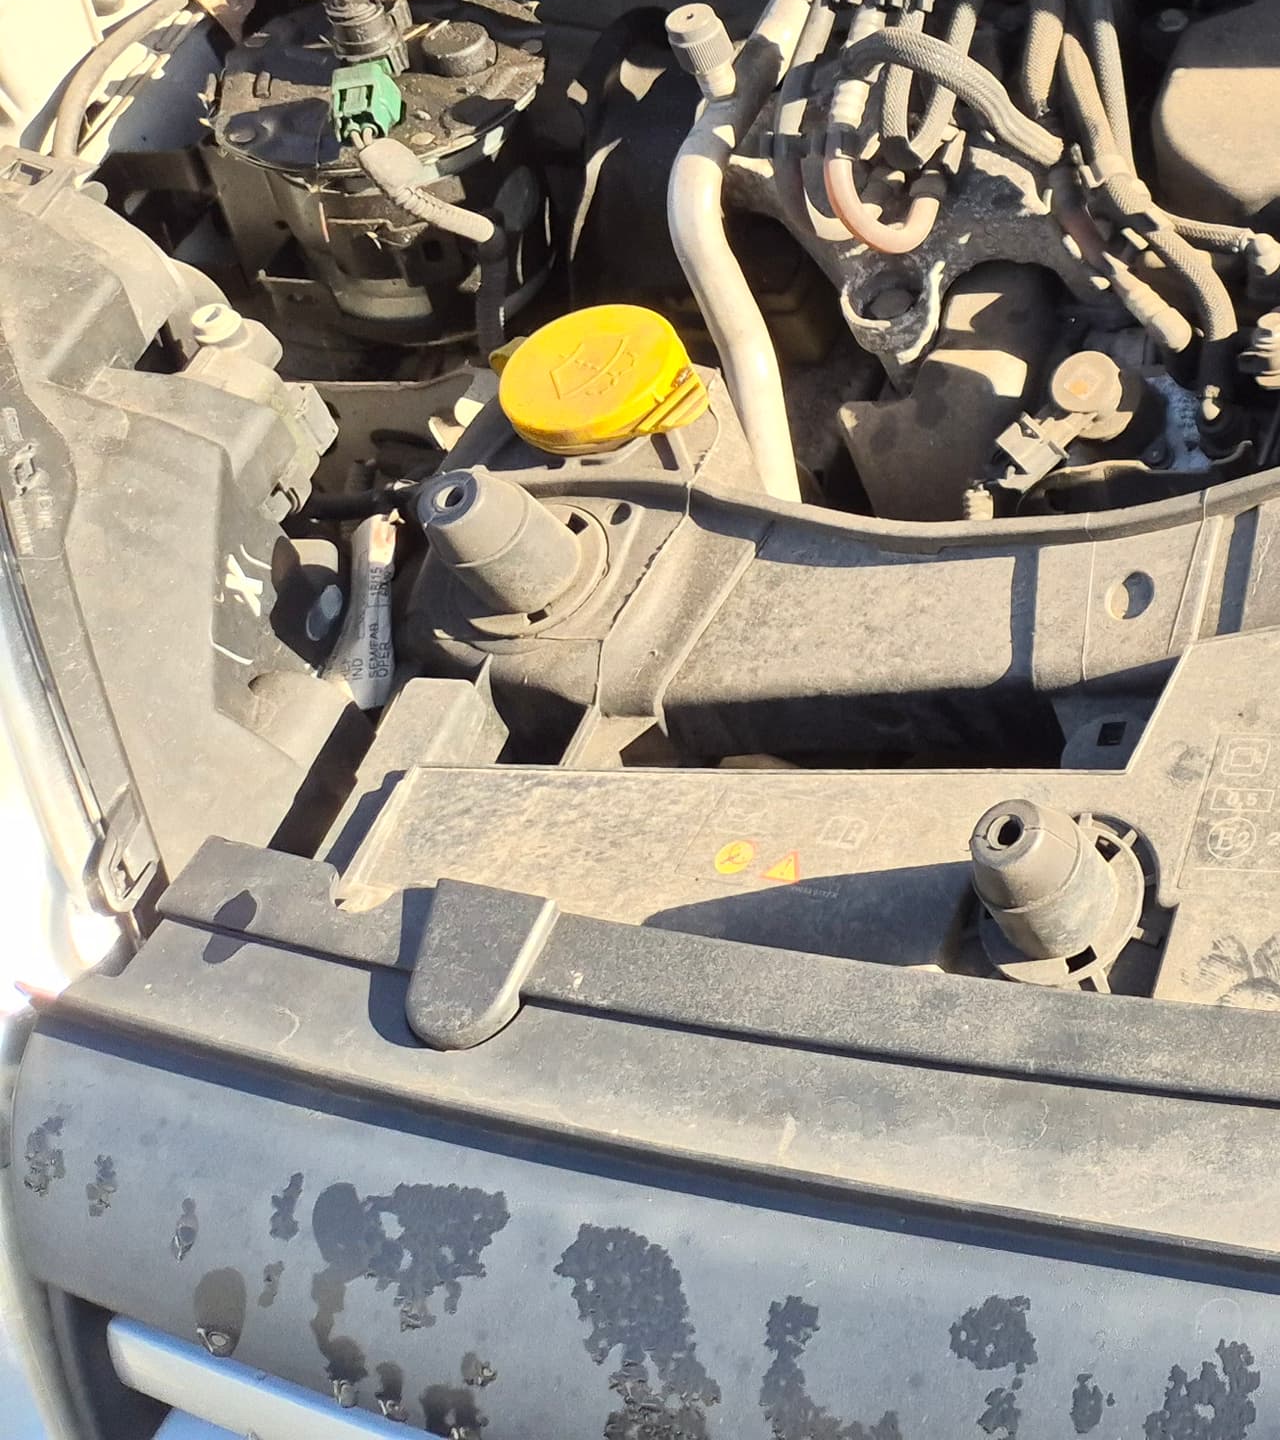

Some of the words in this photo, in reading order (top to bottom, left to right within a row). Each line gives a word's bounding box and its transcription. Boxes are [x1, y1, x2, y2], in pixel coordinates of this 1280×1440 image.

[368, 622, 380, 679] SEMIFAB
[378, 641, 391, 678] OPER
[352, 658, 364, 681] IND
